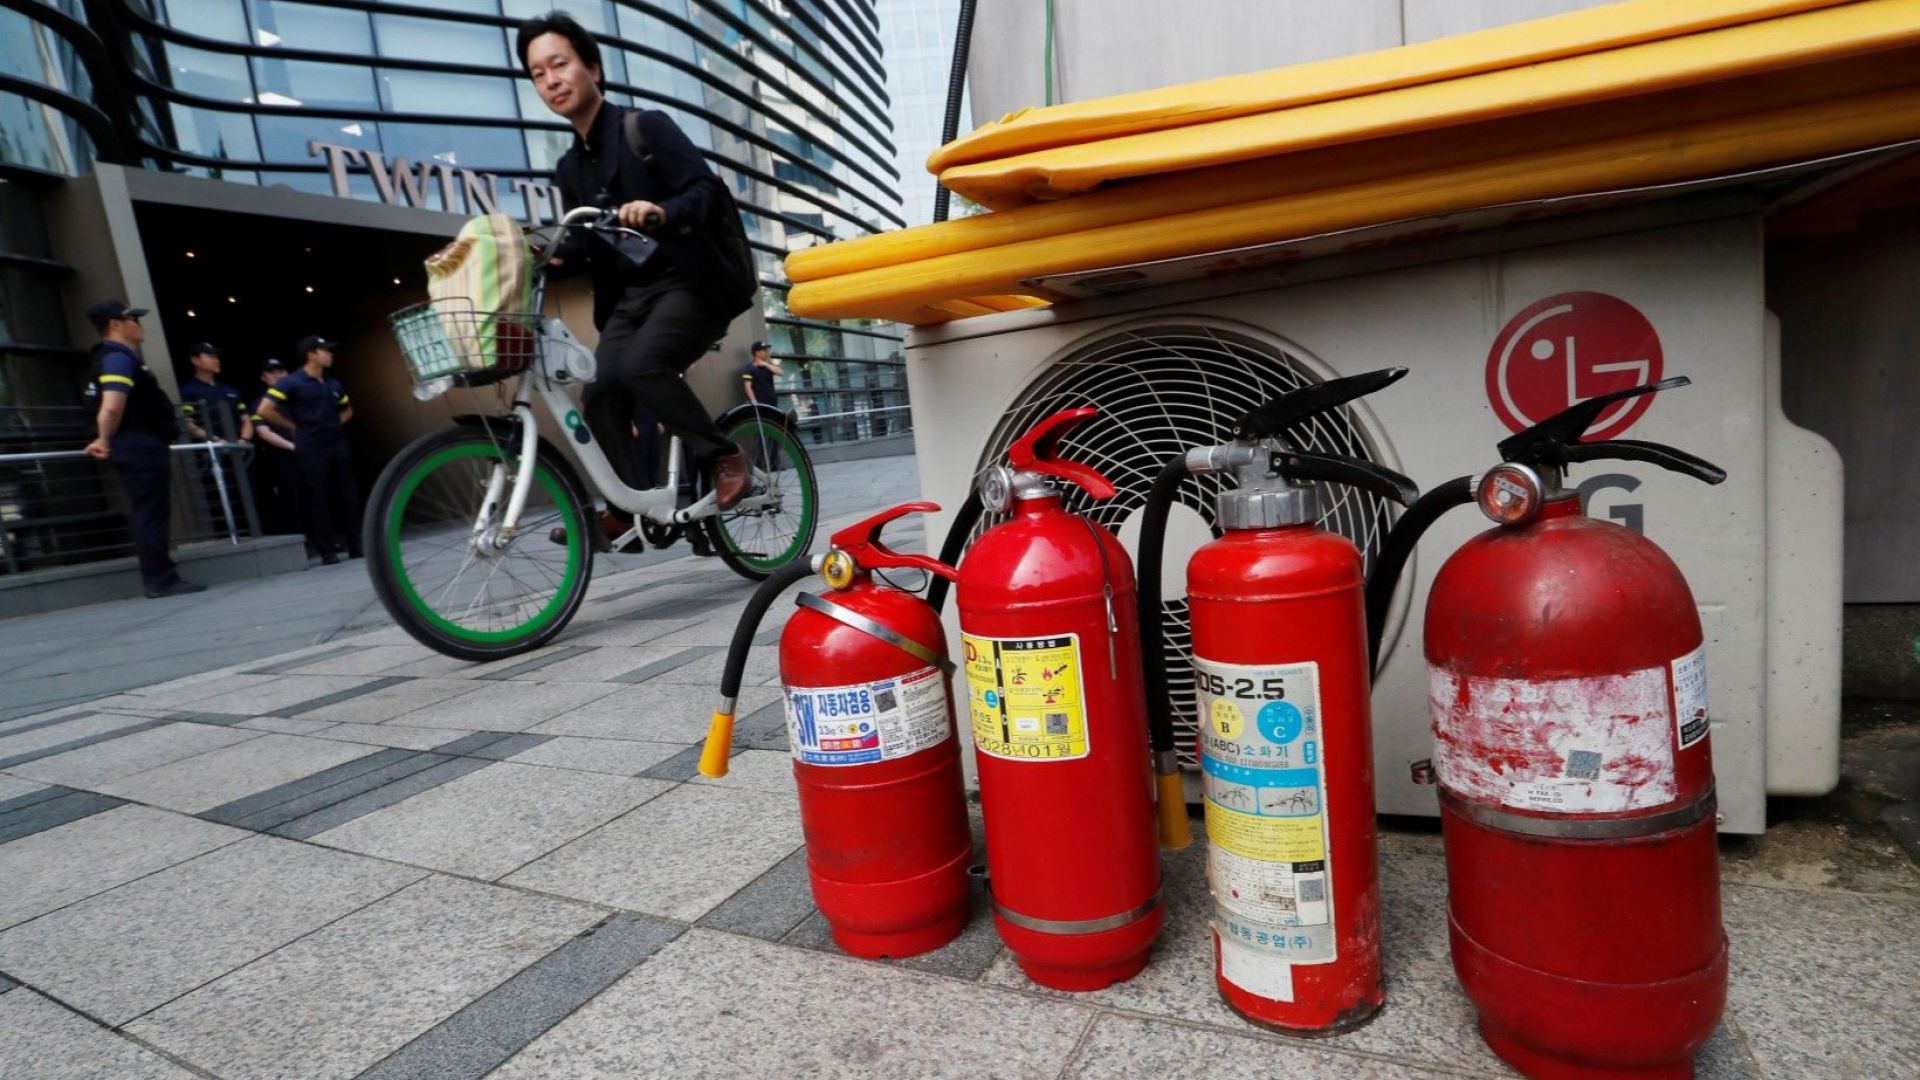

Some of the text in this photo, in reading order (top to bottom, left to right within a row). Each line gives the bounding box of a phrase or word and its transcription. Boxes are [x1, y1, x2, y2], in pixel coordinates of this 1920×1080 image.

[307, 140, 498, 215] TWIN
[1576, 473, 1644, 536] G
[1220, 722, 1230, 733] B
[1273, 726, 1286, 738] C
[1243, 745, 1288, 758] 소화기
